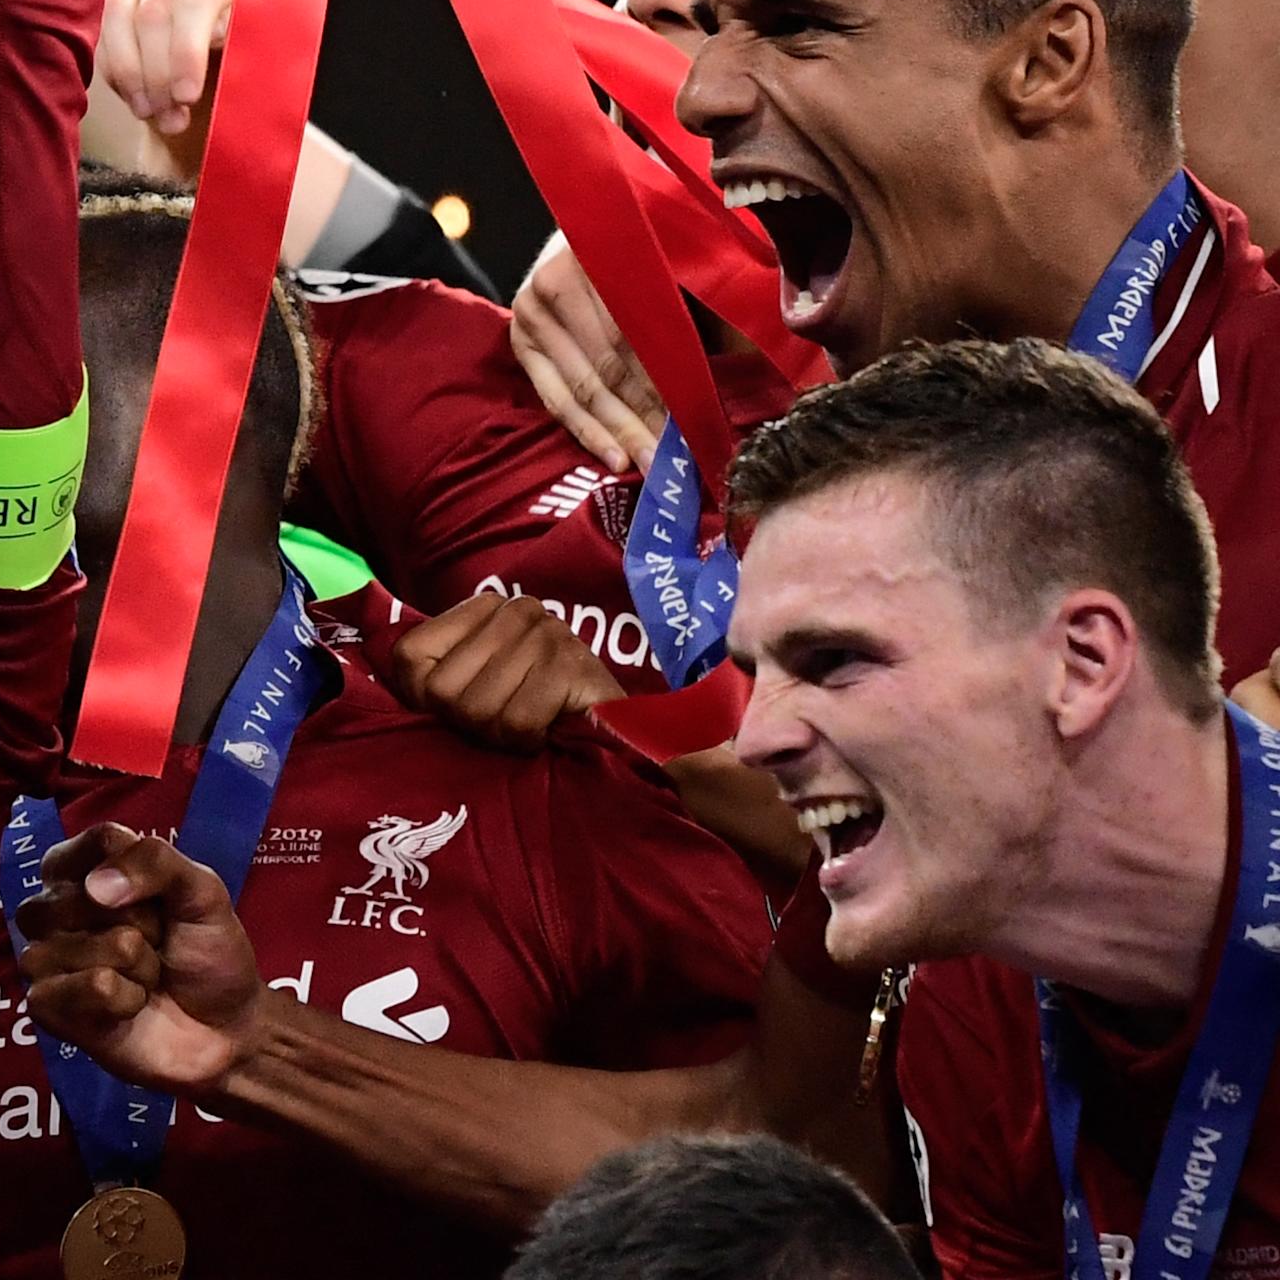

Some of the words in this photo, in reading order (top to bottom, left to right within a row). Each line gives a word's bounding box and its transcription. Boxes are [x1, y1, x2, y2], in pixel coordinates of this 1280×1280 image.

[1167, 197, 1203, 249] FIN
[686, 579, 736, 638] FIN
[242, 648, 302, 735] FINAL
[269, 827, 323, 842] 2019
[288, 842, 322, 853] JUNE
[306, 853, 321, 864] FC
[326, 895, 427, 937] L.F.C.
